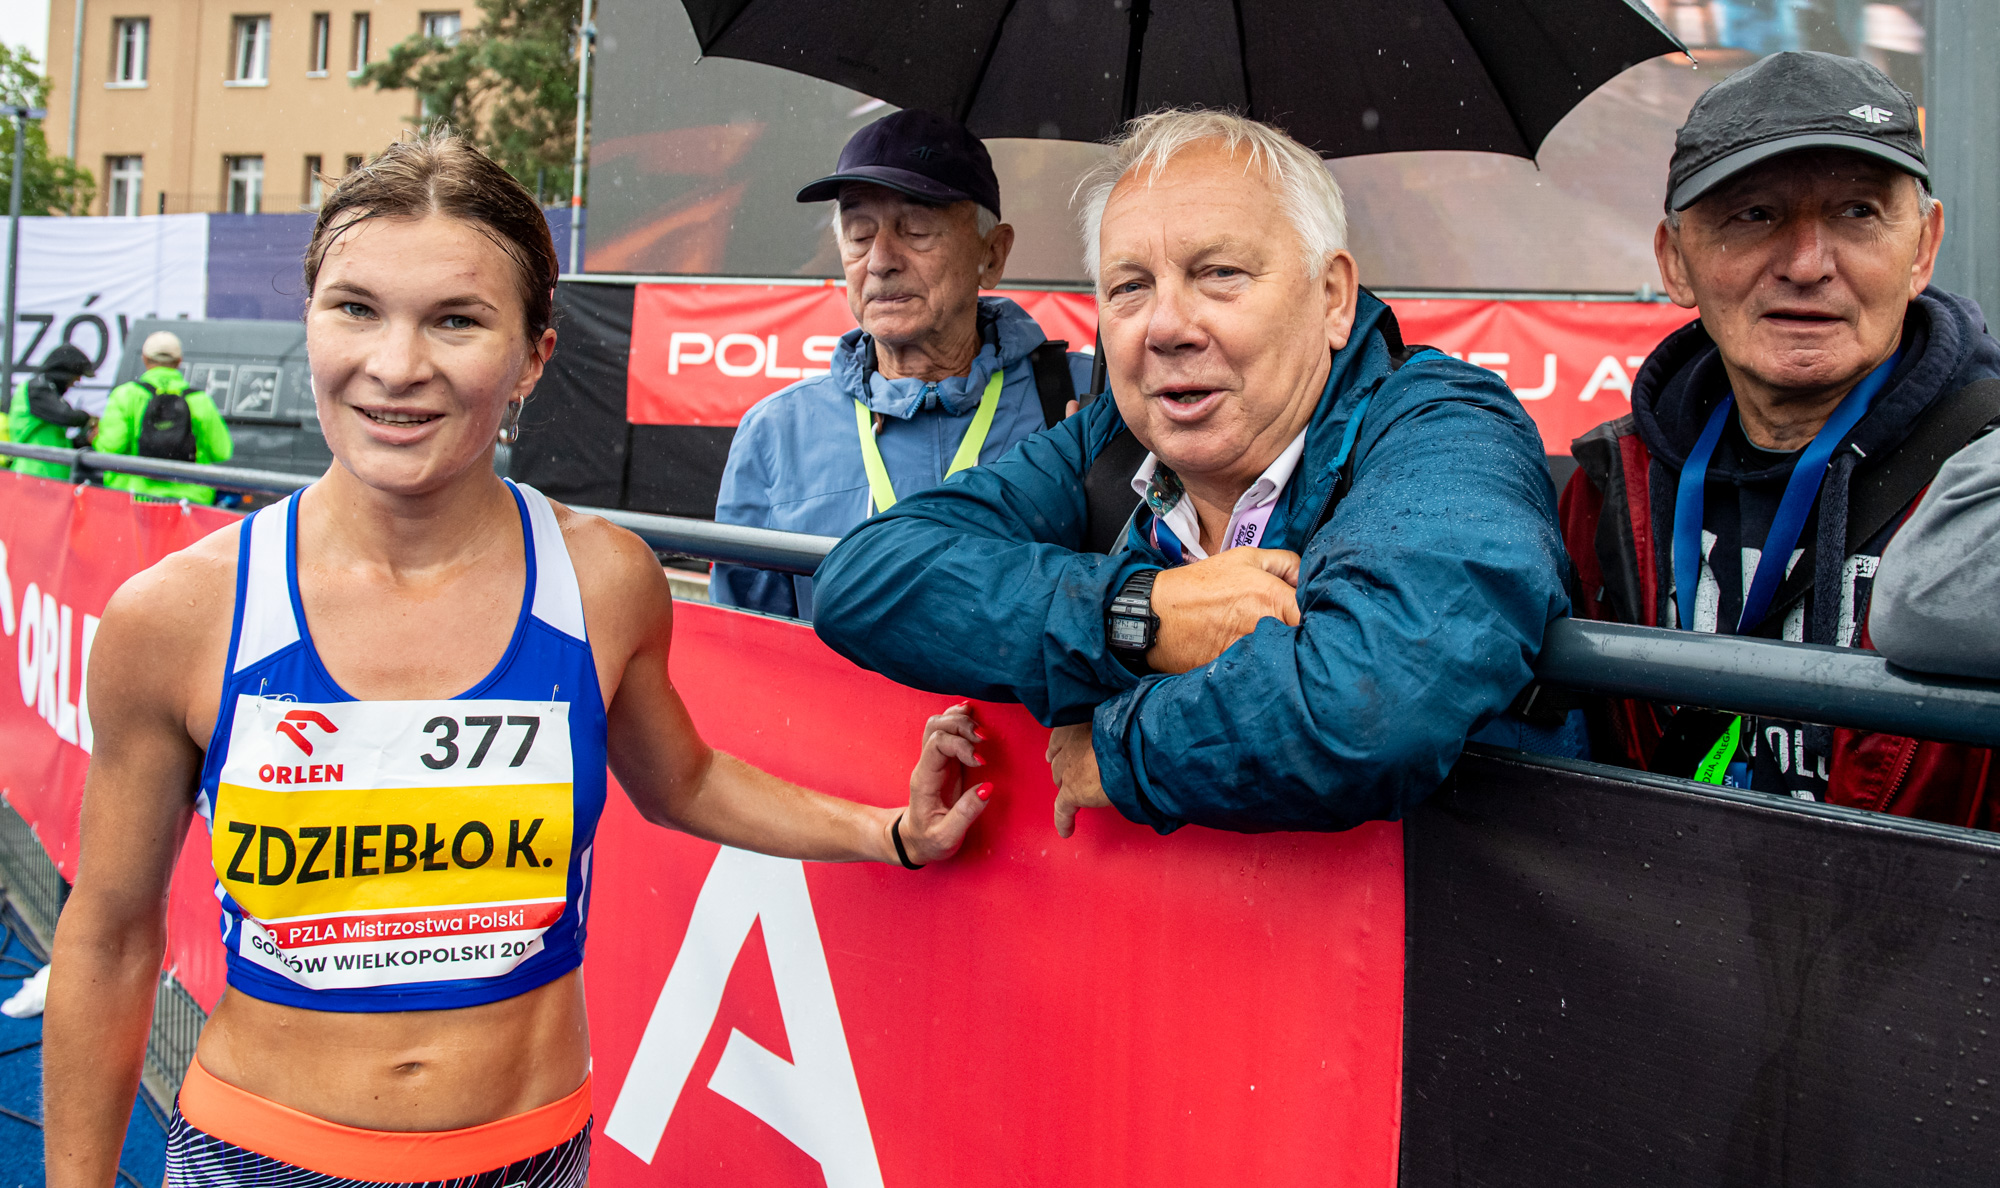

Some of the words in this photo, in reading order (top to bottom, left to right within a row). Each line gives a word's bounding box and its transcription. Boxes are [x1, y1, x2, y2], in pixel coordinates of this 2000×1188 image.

[1242, 523, 1257, 546] GOR
[420, 715, 541, 770] 377
[258, 763, 344, 785] ORLEN
[226, 820, 494, 886] ZDZIEBŁO
[505, 818, 554, 868] K.
[288, 924, 337, 944] PZLA
[343, 917, 463, 939] Mistrzostwa
[469, 909, 525, 930] Polski
[333, 944, 495, 971] WIELKOPOLSKI
